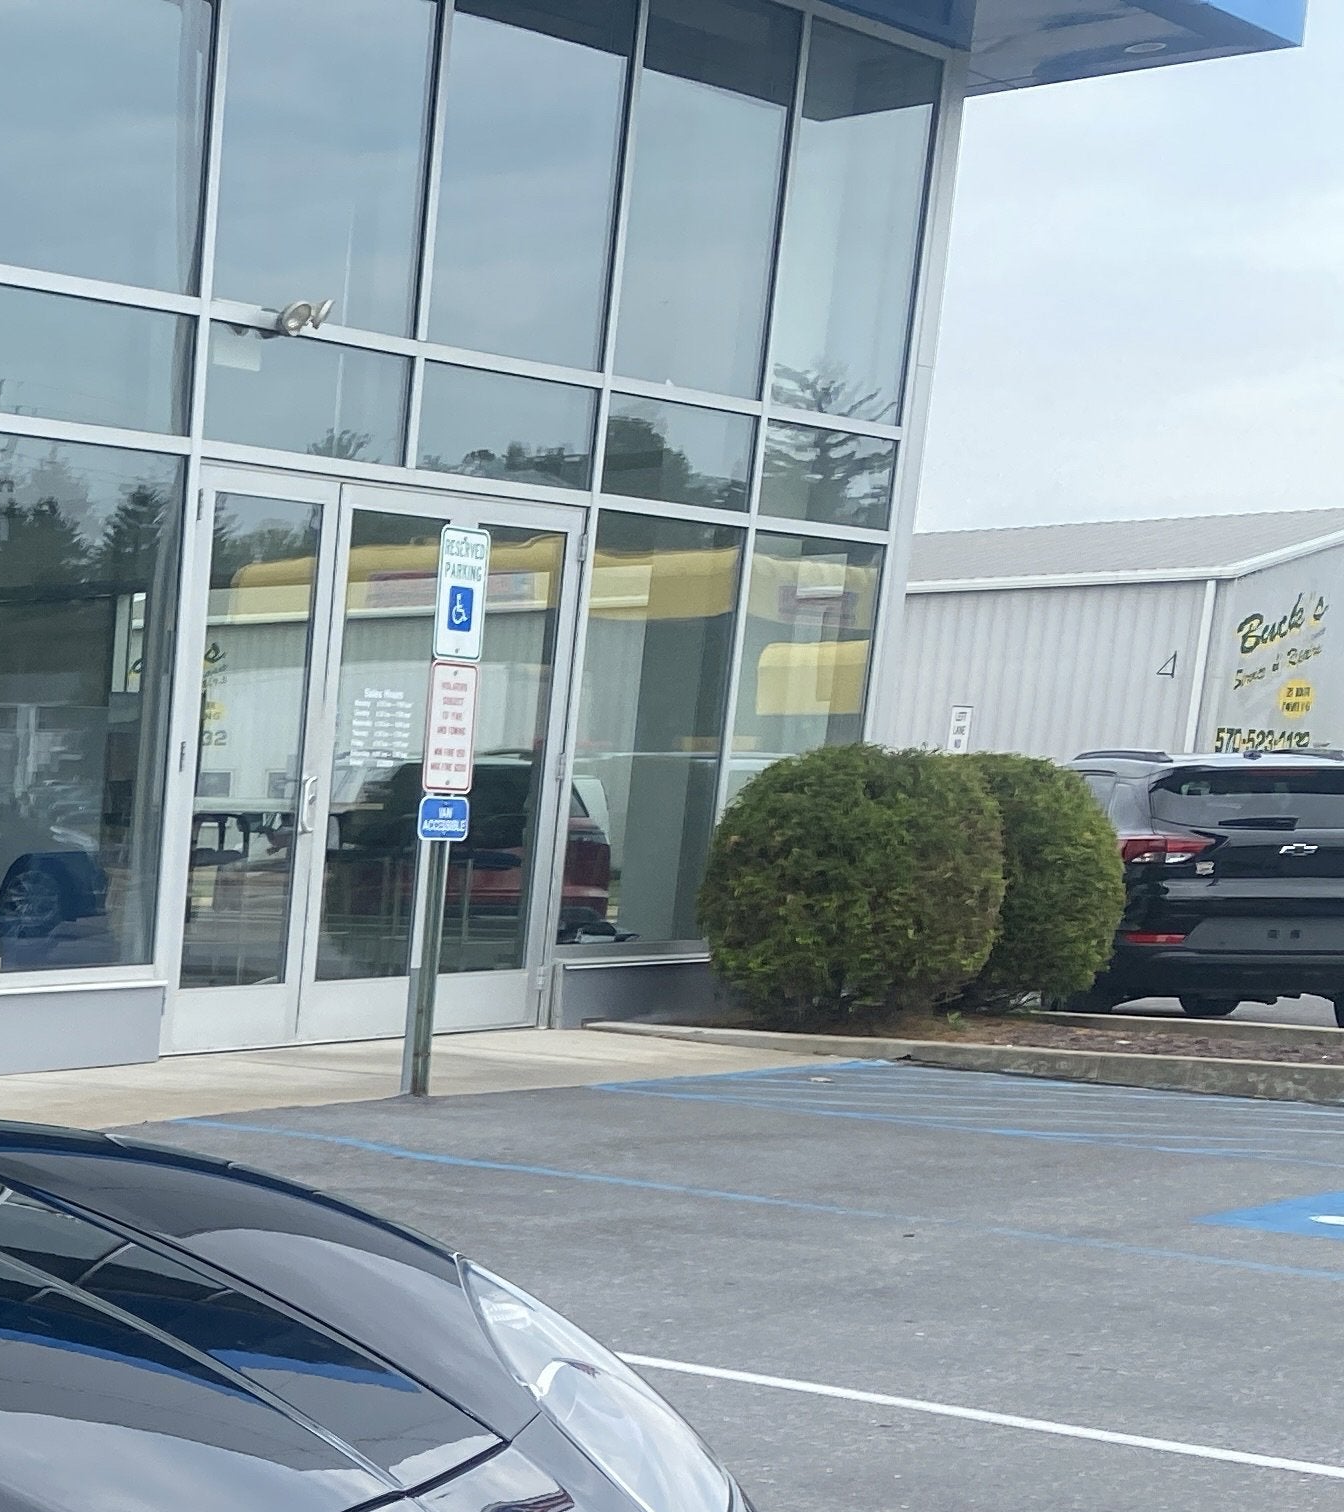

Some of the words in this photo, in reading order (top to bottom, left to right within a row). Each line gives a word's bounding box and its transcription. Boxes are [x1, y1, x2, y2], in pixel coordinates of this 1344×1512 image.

[445, 538, 485, 560] RESERVED
[444, 561, 482, 581] PARKING
[438, 807, 453, 818] VAN
[422, 819, 467, 832] ACCESSIBLE
